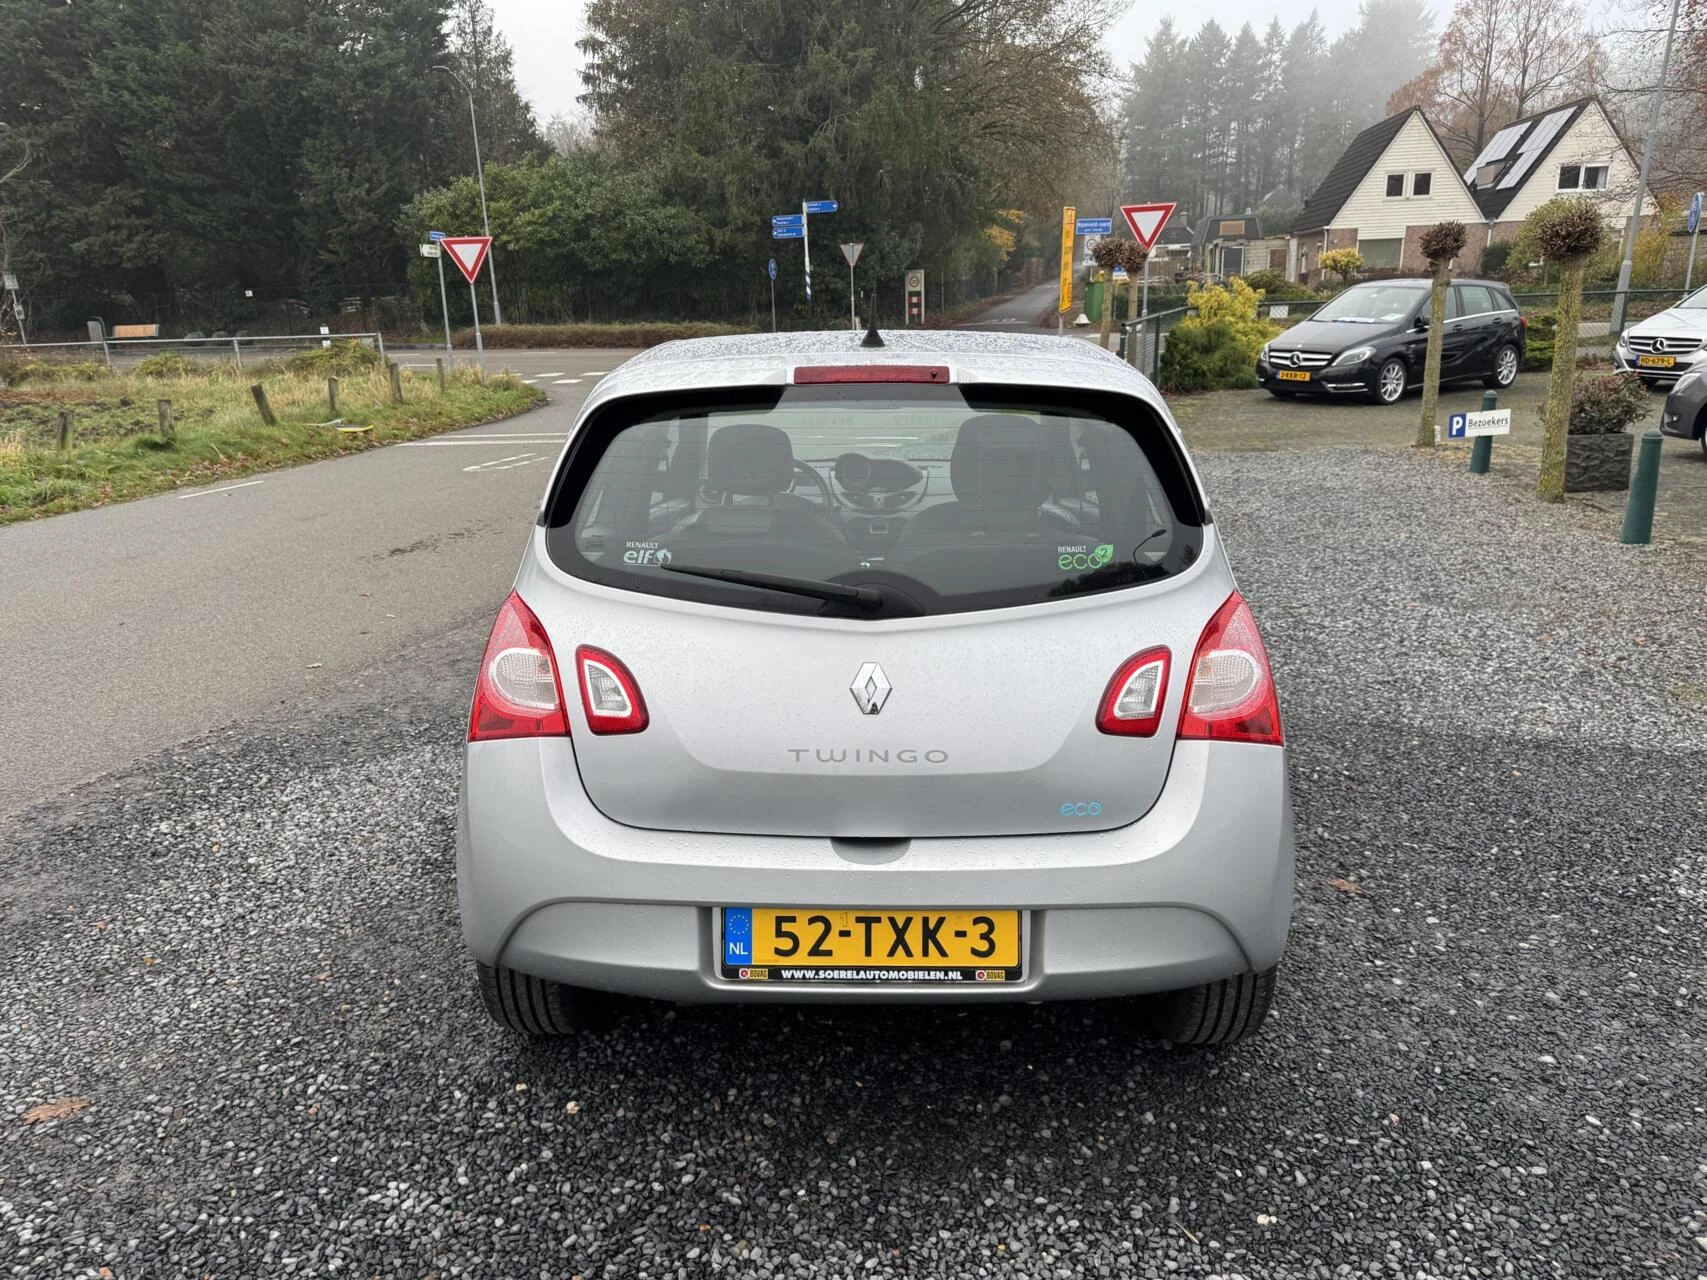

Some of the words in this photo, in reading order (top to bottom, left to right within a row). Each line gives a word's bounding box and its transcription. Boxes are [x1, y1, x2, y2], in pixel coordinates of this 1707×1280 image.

[1452, 416, 1463, 436] P
[1468, 417, 1509, 428] Bezoekers
[626, 541, 659, 549] RENAULT
[1057, 545, 1087, 553] RENAULT
[623, 549, 655, 564] elf
[787, 748, 949, 764] TWINGO
[1061, 802, 1102, 817] eco
[773, 915, 996, 958] 52-TXK-3
[729, 942, 748, 955] NL
[781, 969, 963, 980] WWW.SOERELAUTOMOBIELEN.NL
